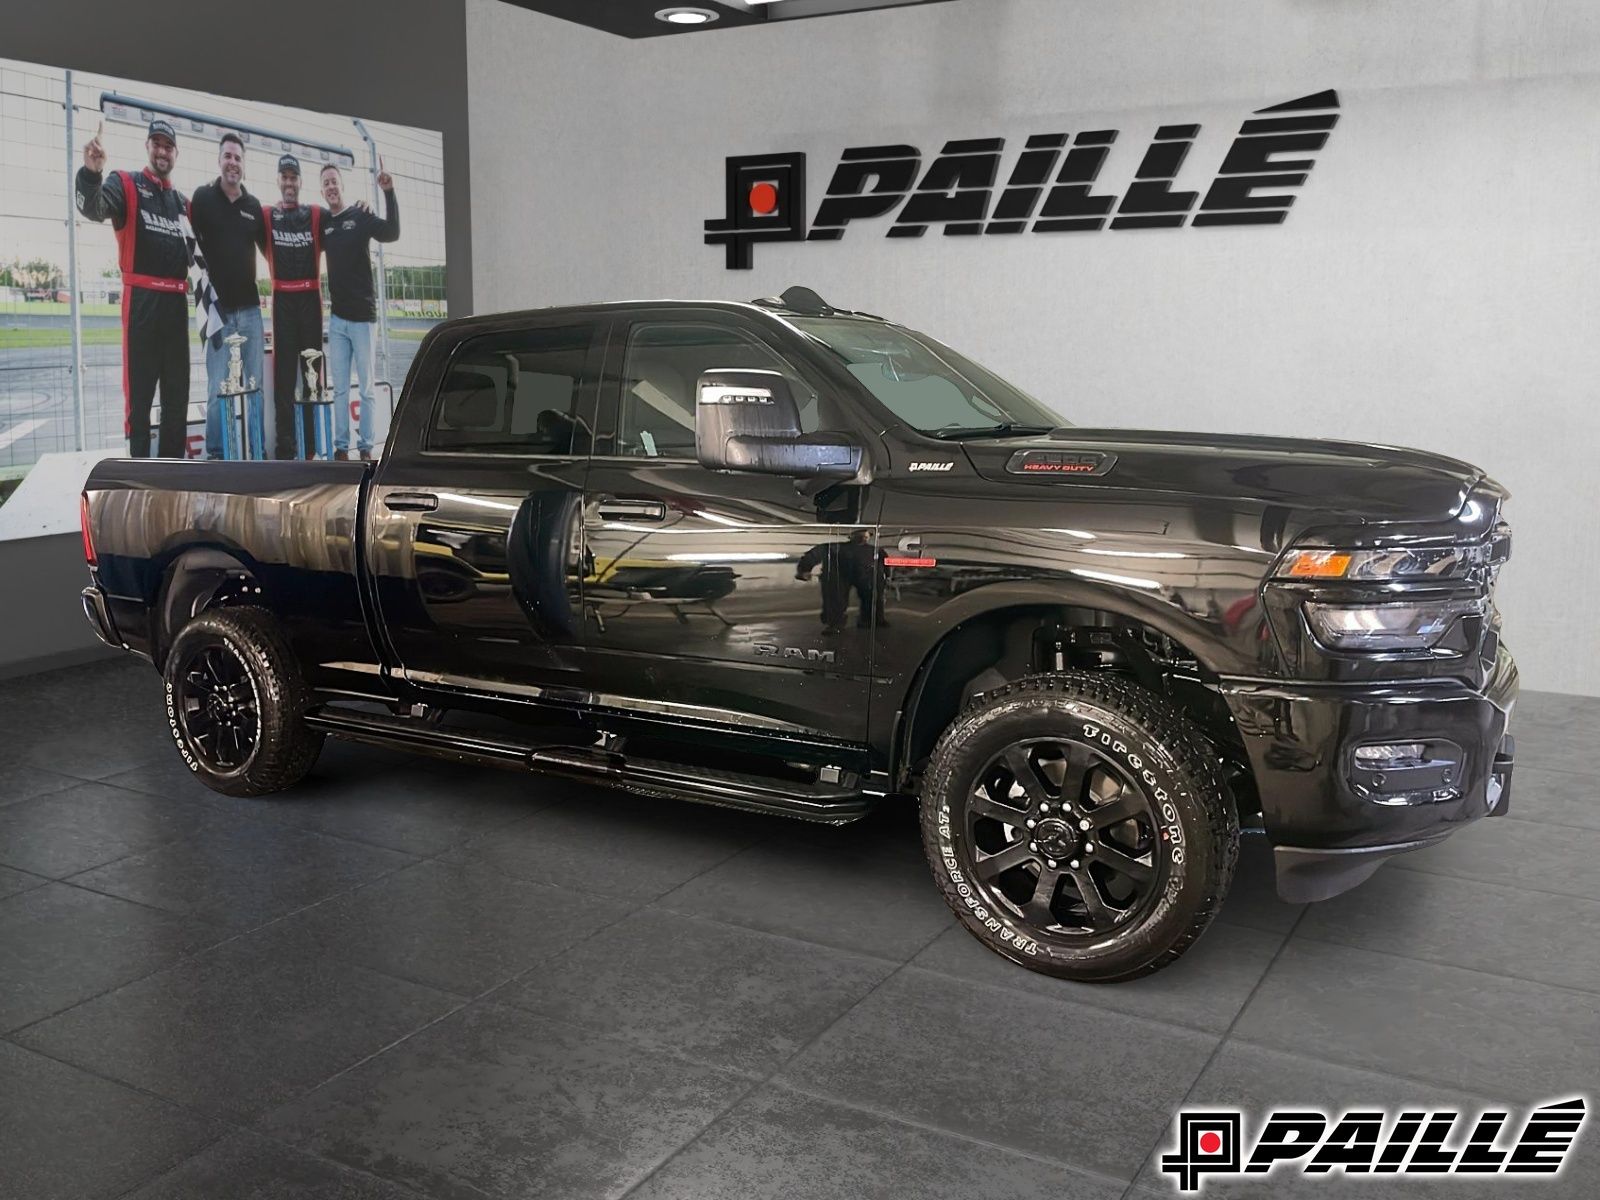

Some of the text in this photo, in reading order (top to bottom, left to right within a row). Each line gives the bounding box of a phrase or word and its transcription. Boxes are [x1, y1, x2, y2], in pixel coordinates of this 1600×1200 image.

[806, 88, 1341, 240] PAILLÉ
[1023, 463, 1062, 471] HEAVY
[753, 642, 835, 663] RAM
[940, 846, 1038, 956] TRANSFORCE
